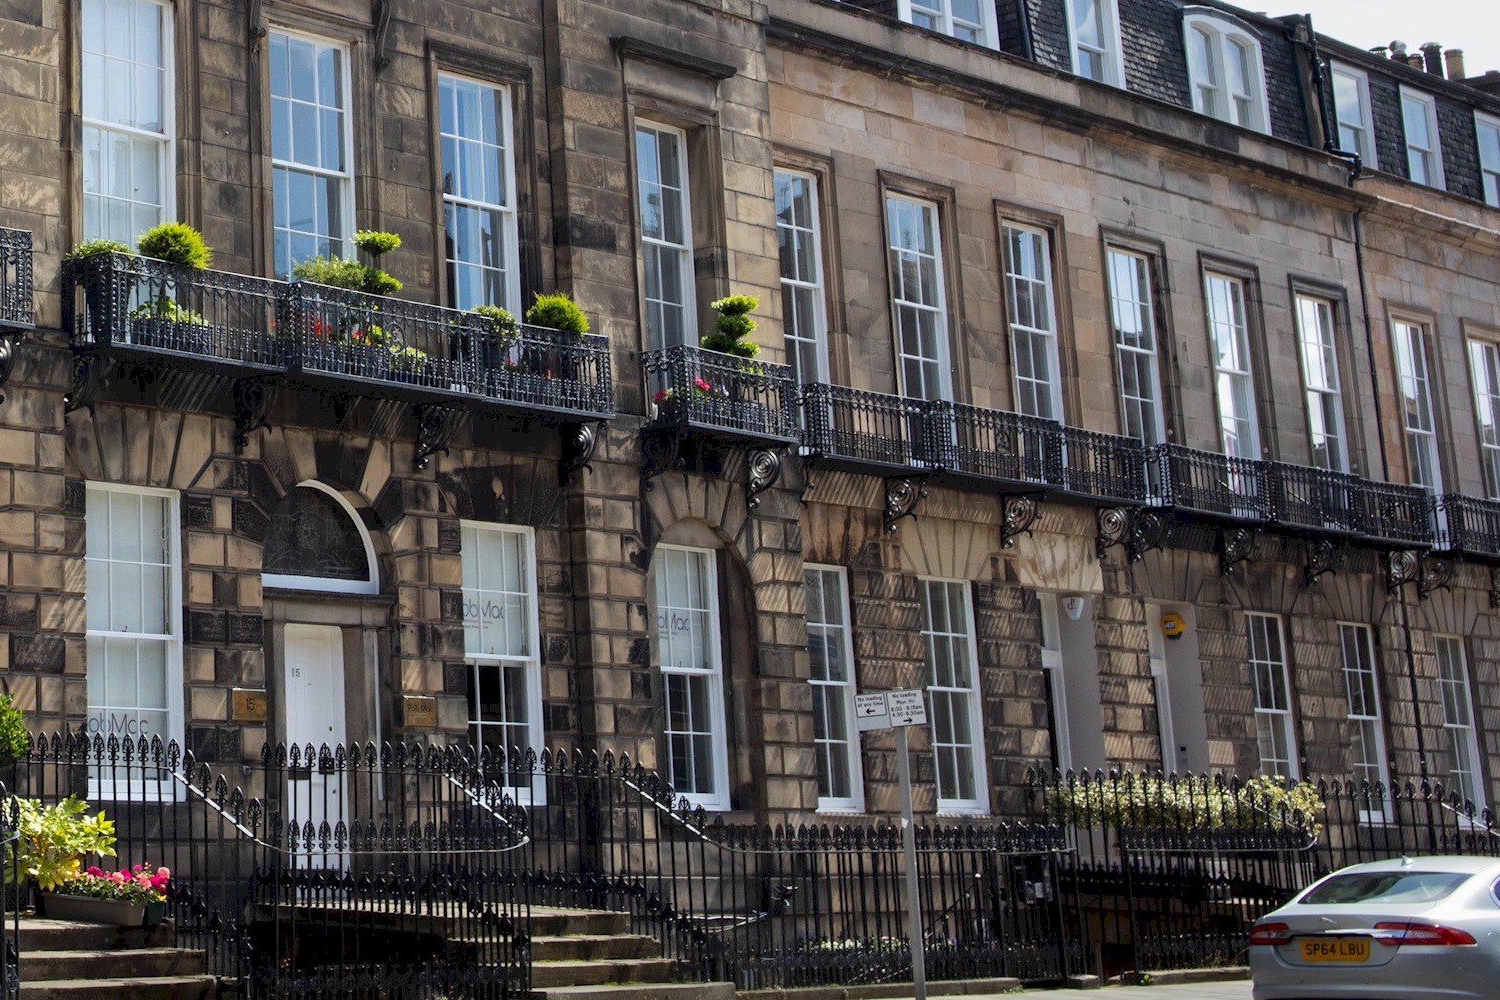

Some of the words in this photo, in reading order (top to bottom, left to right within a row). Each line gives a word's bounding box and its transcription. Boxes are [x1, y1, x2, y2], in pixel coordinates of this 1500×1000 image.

[291, 668, 301, 678] 15
[246, 698, 256, 711] 15
[1306, 943, 1336, 956] SP64
[1340, 943, 1364, 956] LBU
